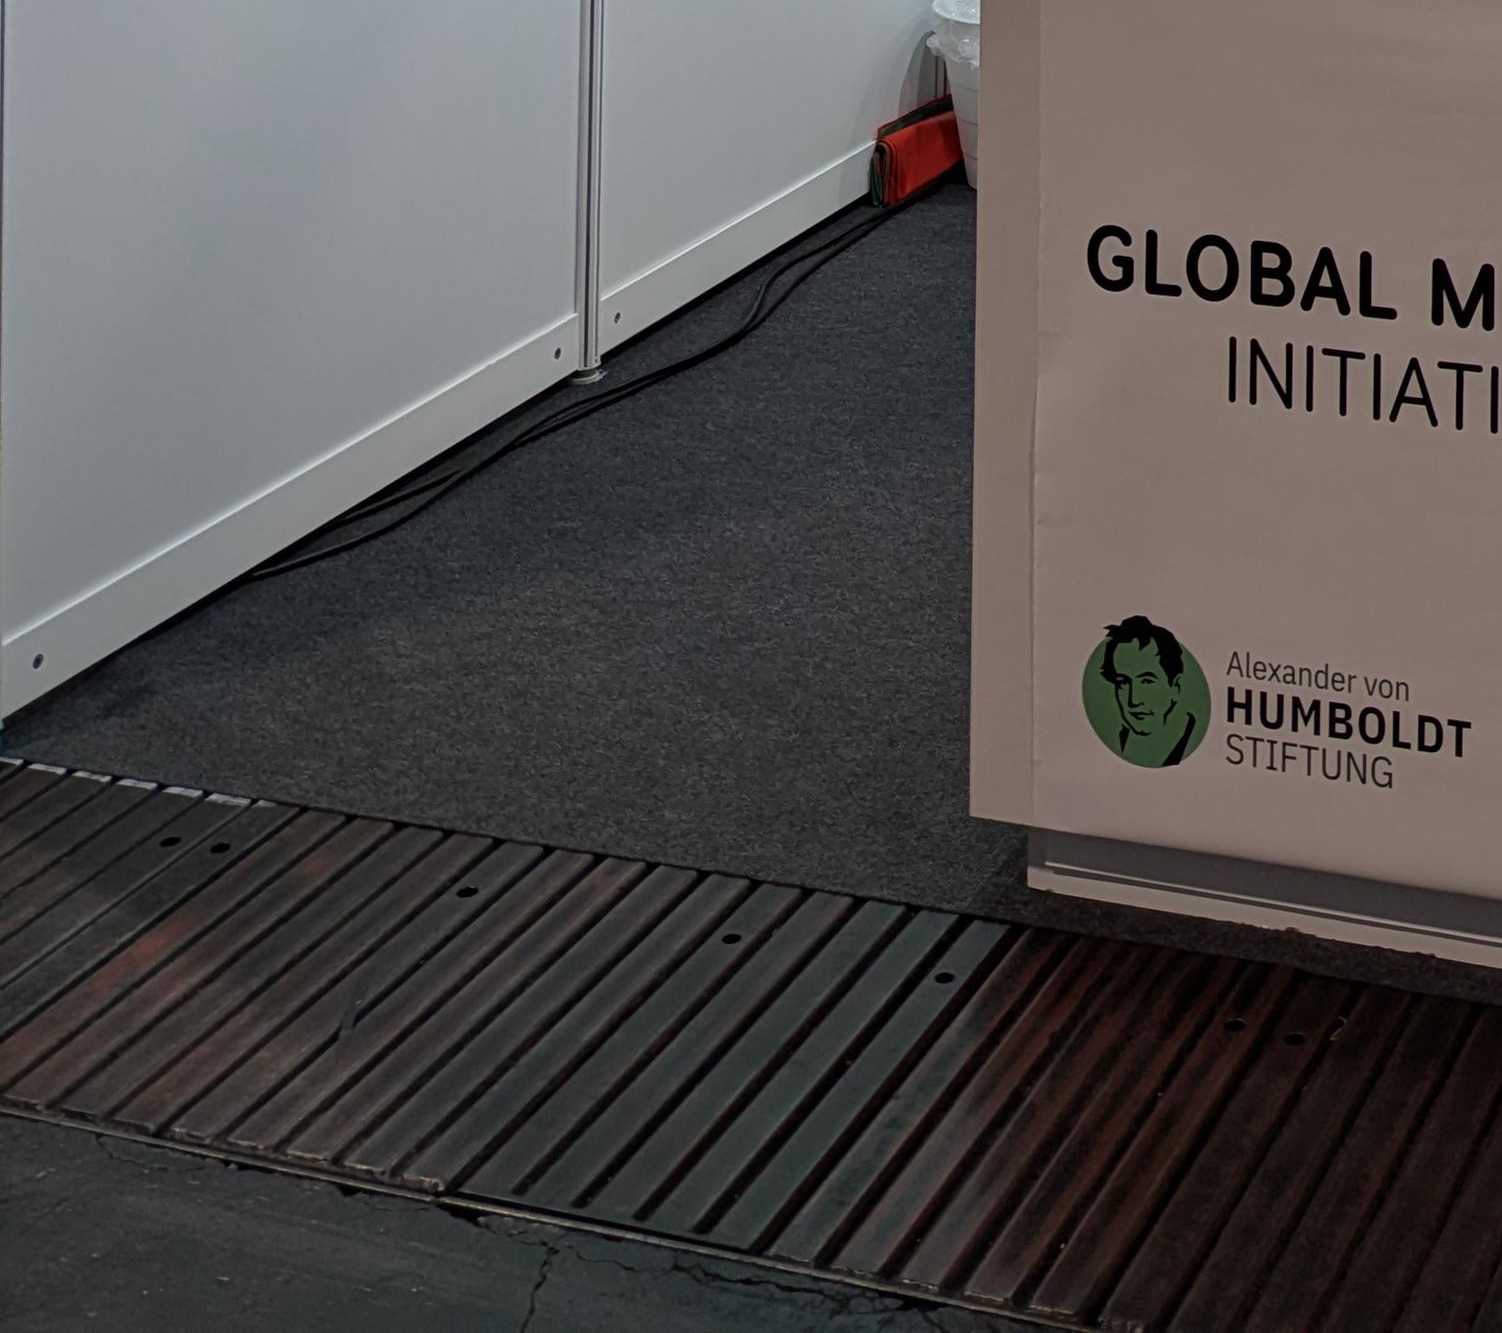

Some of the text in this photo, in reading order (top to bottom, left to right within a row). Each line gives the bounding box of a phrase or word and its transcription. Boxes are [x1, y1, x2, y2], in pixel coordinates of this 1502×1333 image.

[1086, 224, 1397, 322] GLOBAL
[1226, 650, 1409, 703] Alexander von
[1226, 687, 1472, 759] HUMBOLDT
[1225, 735, 1394, 790] STIFTUNG
